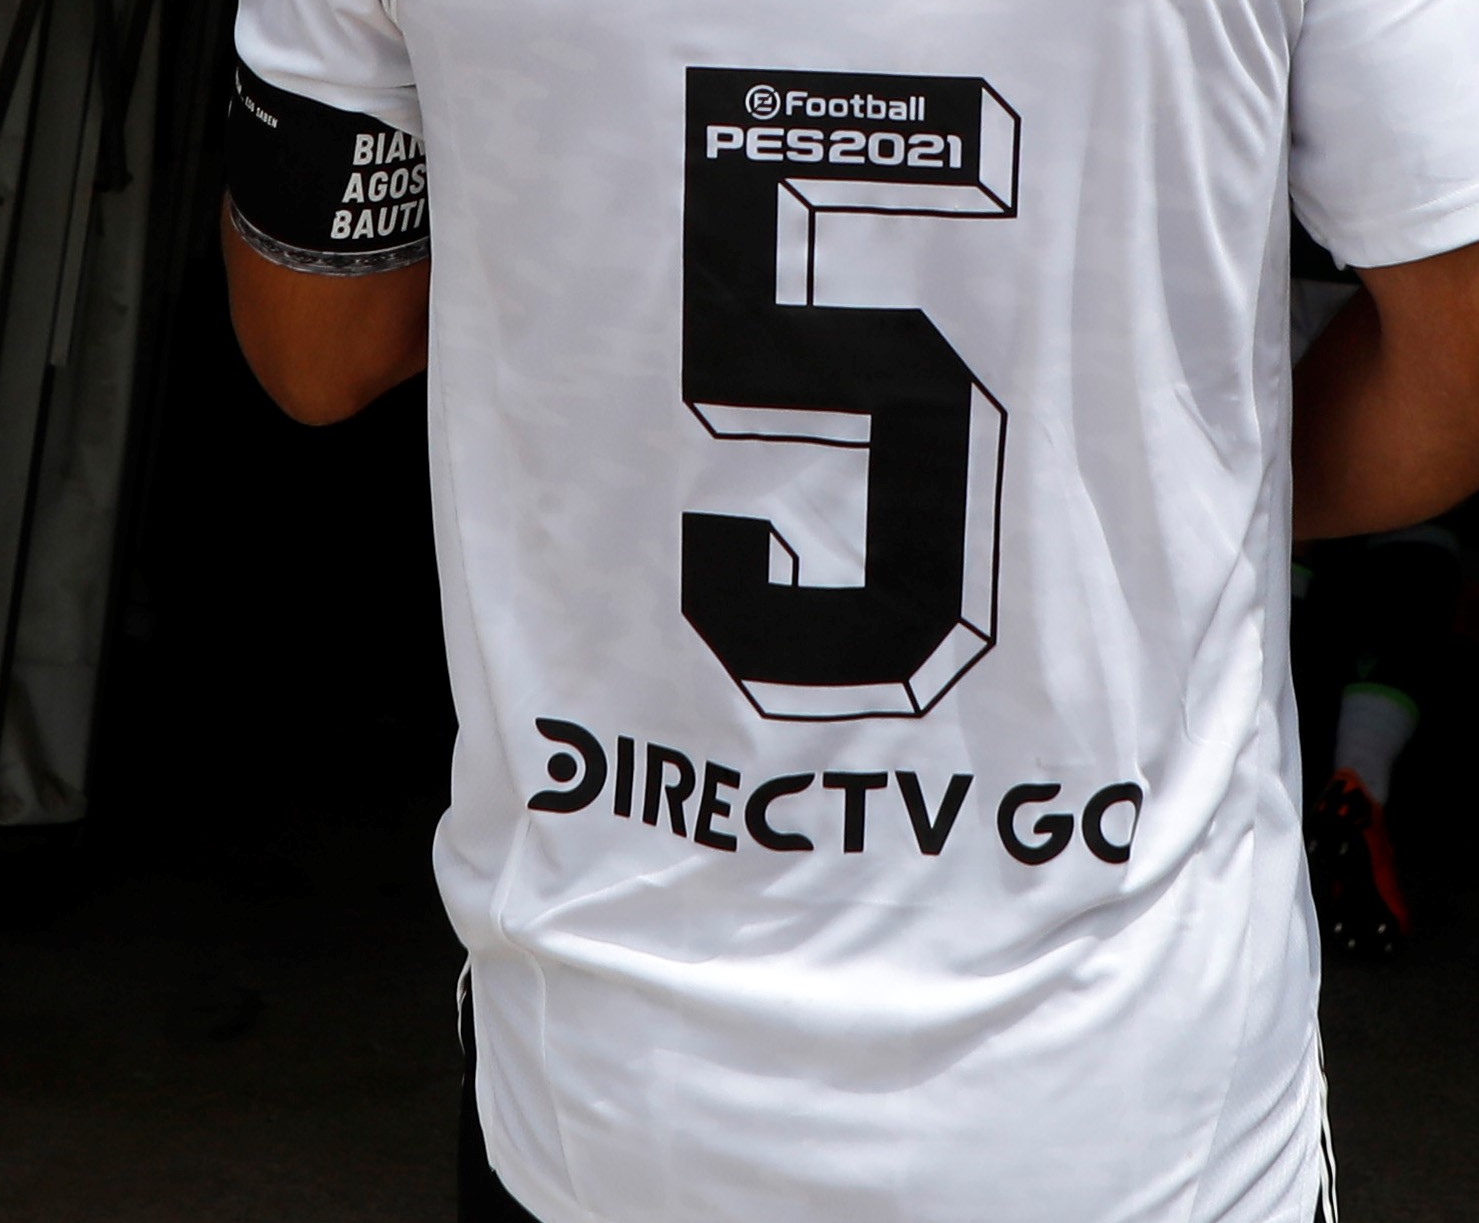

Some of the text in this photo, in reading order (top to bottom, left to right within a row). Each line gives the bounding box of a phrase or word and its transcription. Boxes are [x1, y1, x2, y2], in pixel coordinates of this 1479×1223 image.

[706, 125, 962, 169] PES2021
[341, 163, 426, 204] AGOS
[330, 197, 426, 240] BAUTI
[681, 66, 1021, 721] 5
[527, 717, 1143, 865] DIRECTV GO
